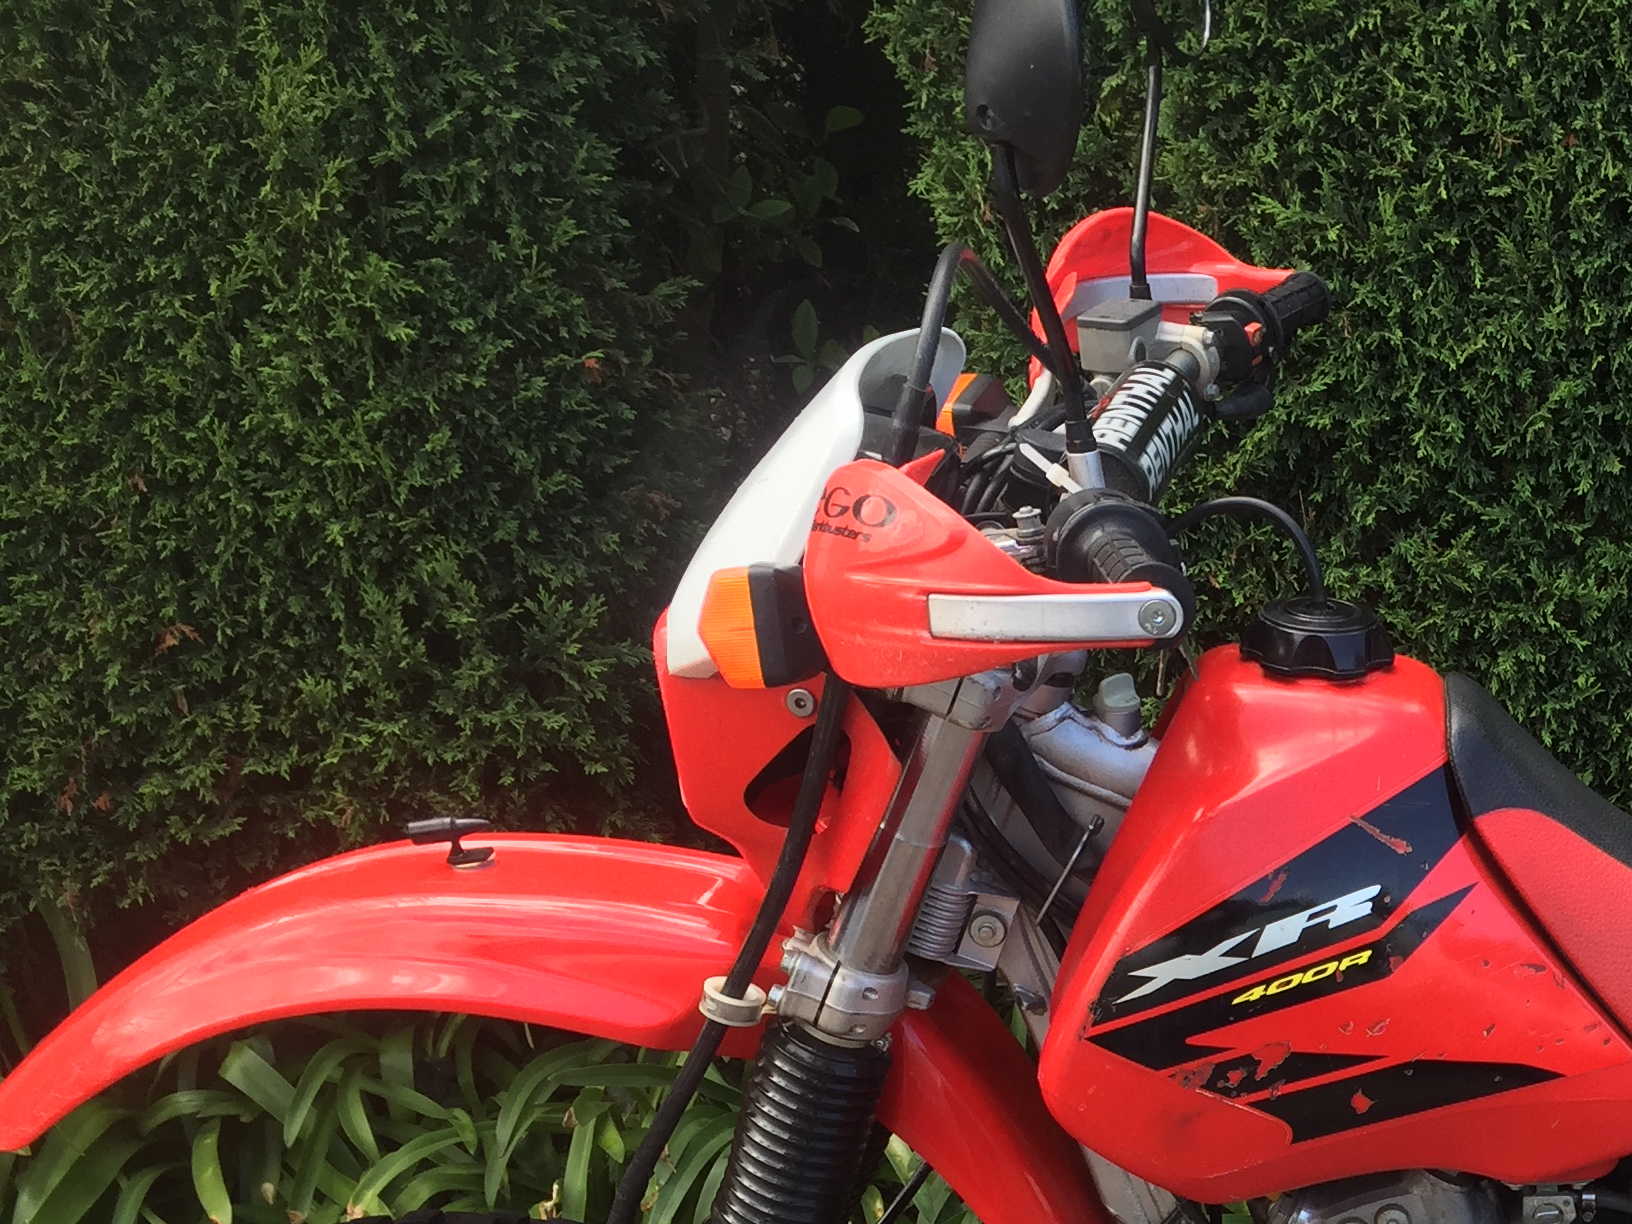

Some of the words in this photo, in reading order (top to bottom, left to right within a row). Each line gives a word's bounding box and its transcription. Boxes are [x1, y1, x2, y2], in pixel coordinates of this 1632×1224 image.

[1092, 367, 1178, 453] RENTHAL
[1137, 388, 1200, 502] RENTHAL
[1112, 884, 1382, 1005] XR
[1231, 949, 1373, 1006] 400R
